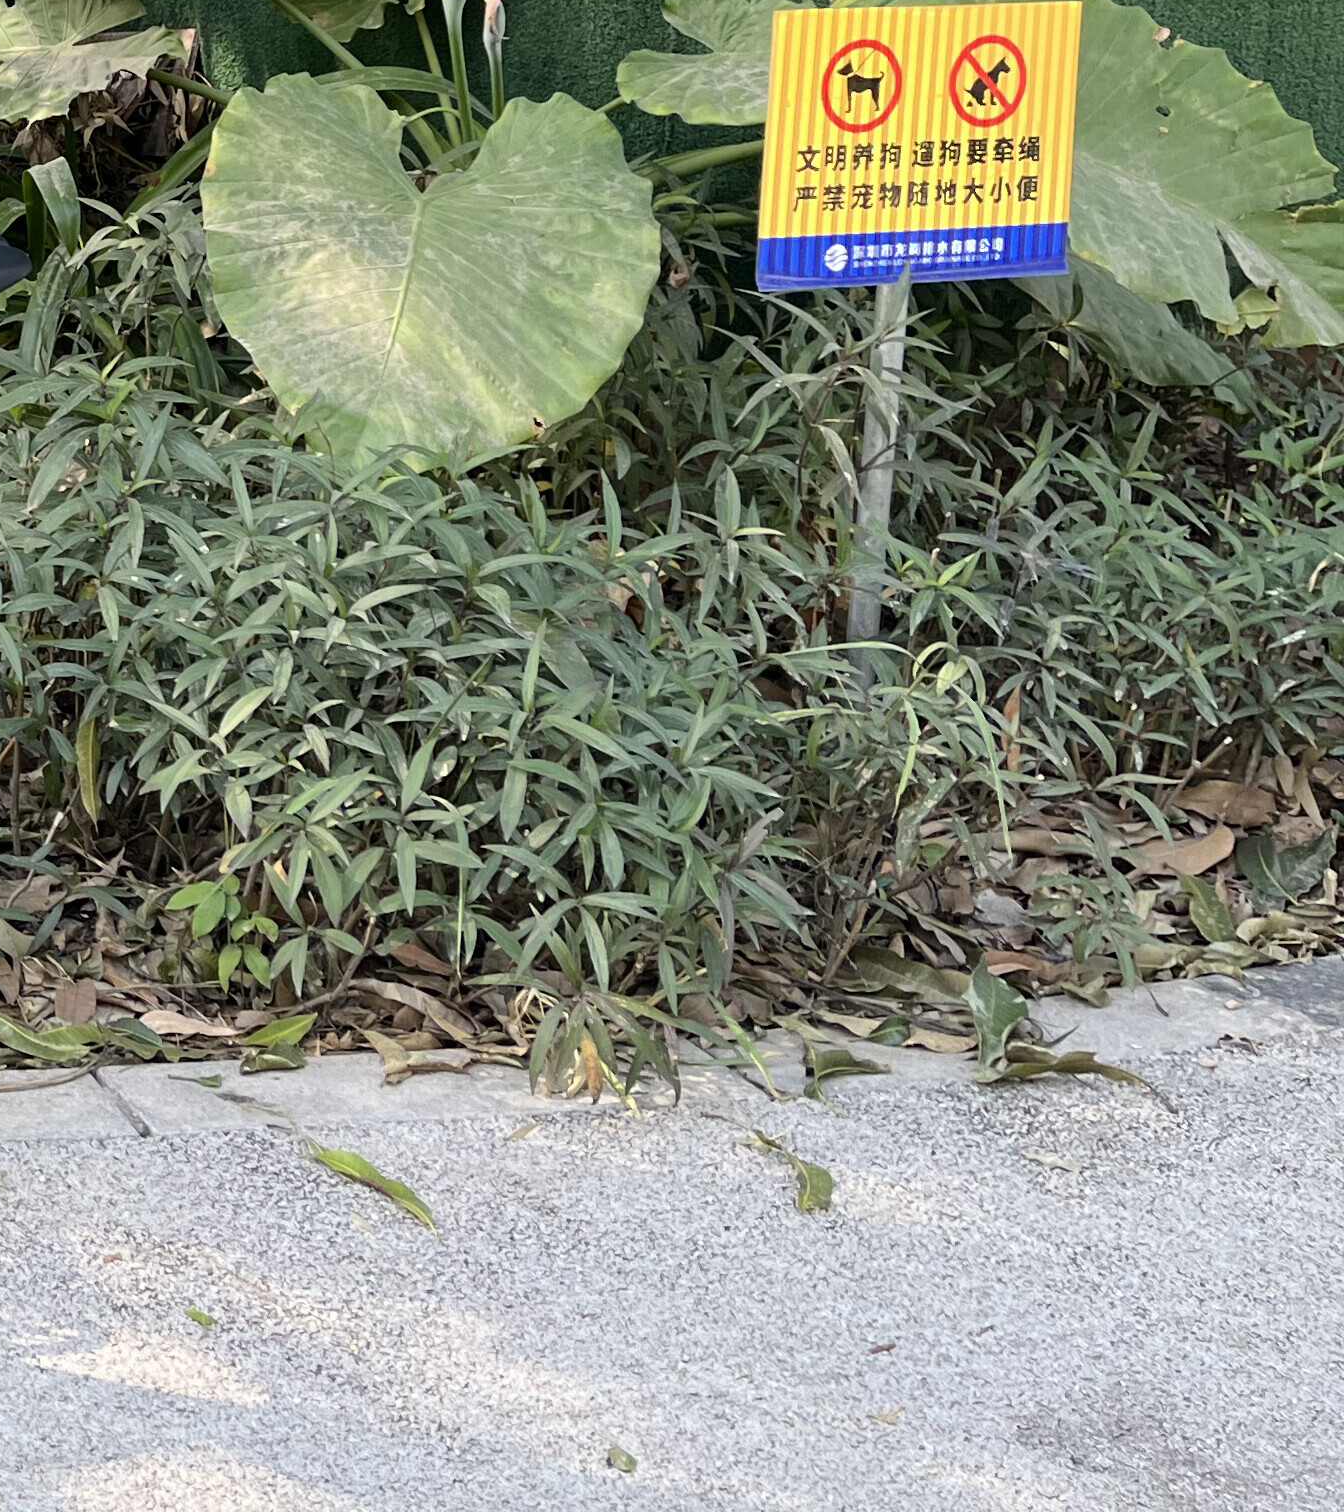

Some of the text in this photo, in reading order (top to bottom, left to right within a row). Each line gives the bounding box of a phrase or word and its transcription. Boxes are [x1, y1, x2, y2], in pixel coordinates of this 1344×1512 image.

[796, 135, 1041, 173] 文明养狗 遛狗要牵绳
[793, 174, 1039, 212] 严禁宠物随地大小便
